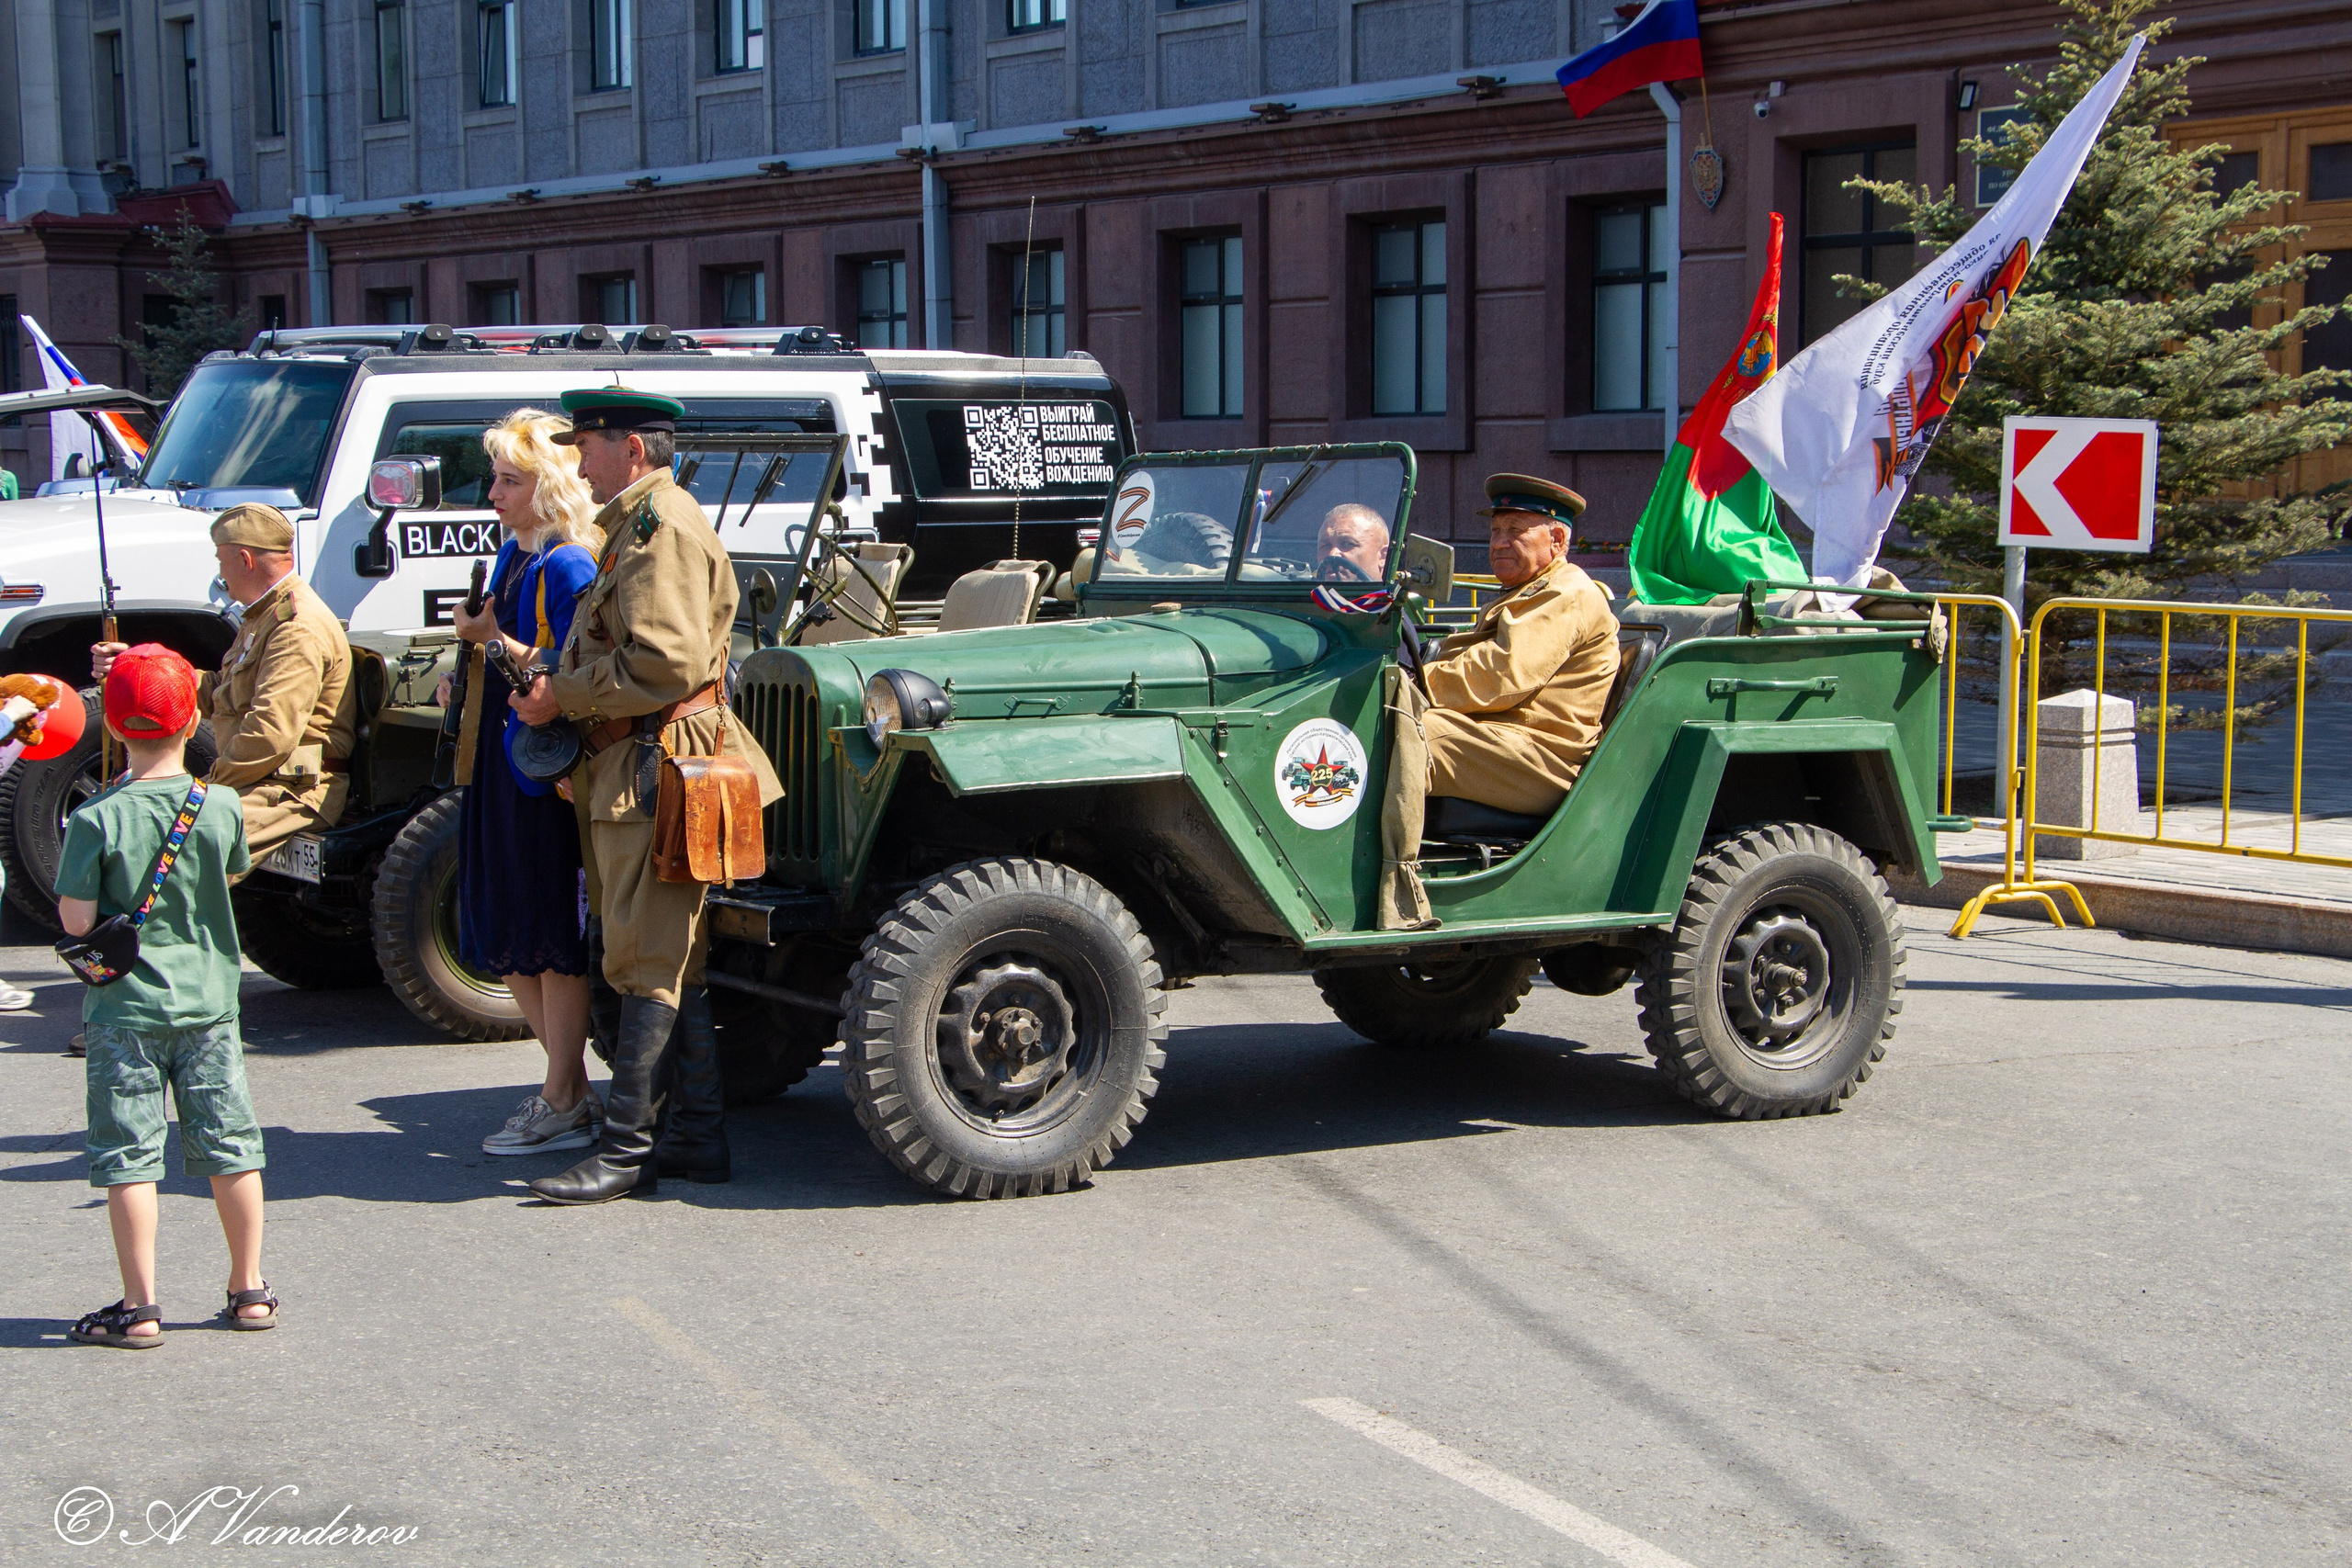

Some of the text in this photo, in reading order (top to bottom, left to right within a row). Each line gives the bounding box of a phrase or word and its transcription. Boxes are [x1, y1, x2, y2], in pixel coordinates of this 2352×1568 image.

[1039, 403, 1095, 423] ВЫИГРАЙ
[1042, 424, 1115, 441] БЕСПЛАТНОЕ
[1045, 446, 1104, 464] ОБУЧЕНИЕ
[1046, 466, 1114, 484] ВОЖДЕНИЮ
[1114, 486, 1150, 532] Z
[406, 524, 497, 555] BLACK
[1311, 767, 1333, 782] 225
[185, 776, 207, 812] LOVE
[167, 812, 194, 852] LOVE
[303, 843, 316, 868] 55
[153, 852, 175, 893] LOVE
[134, 893, 155, 928] OVE
